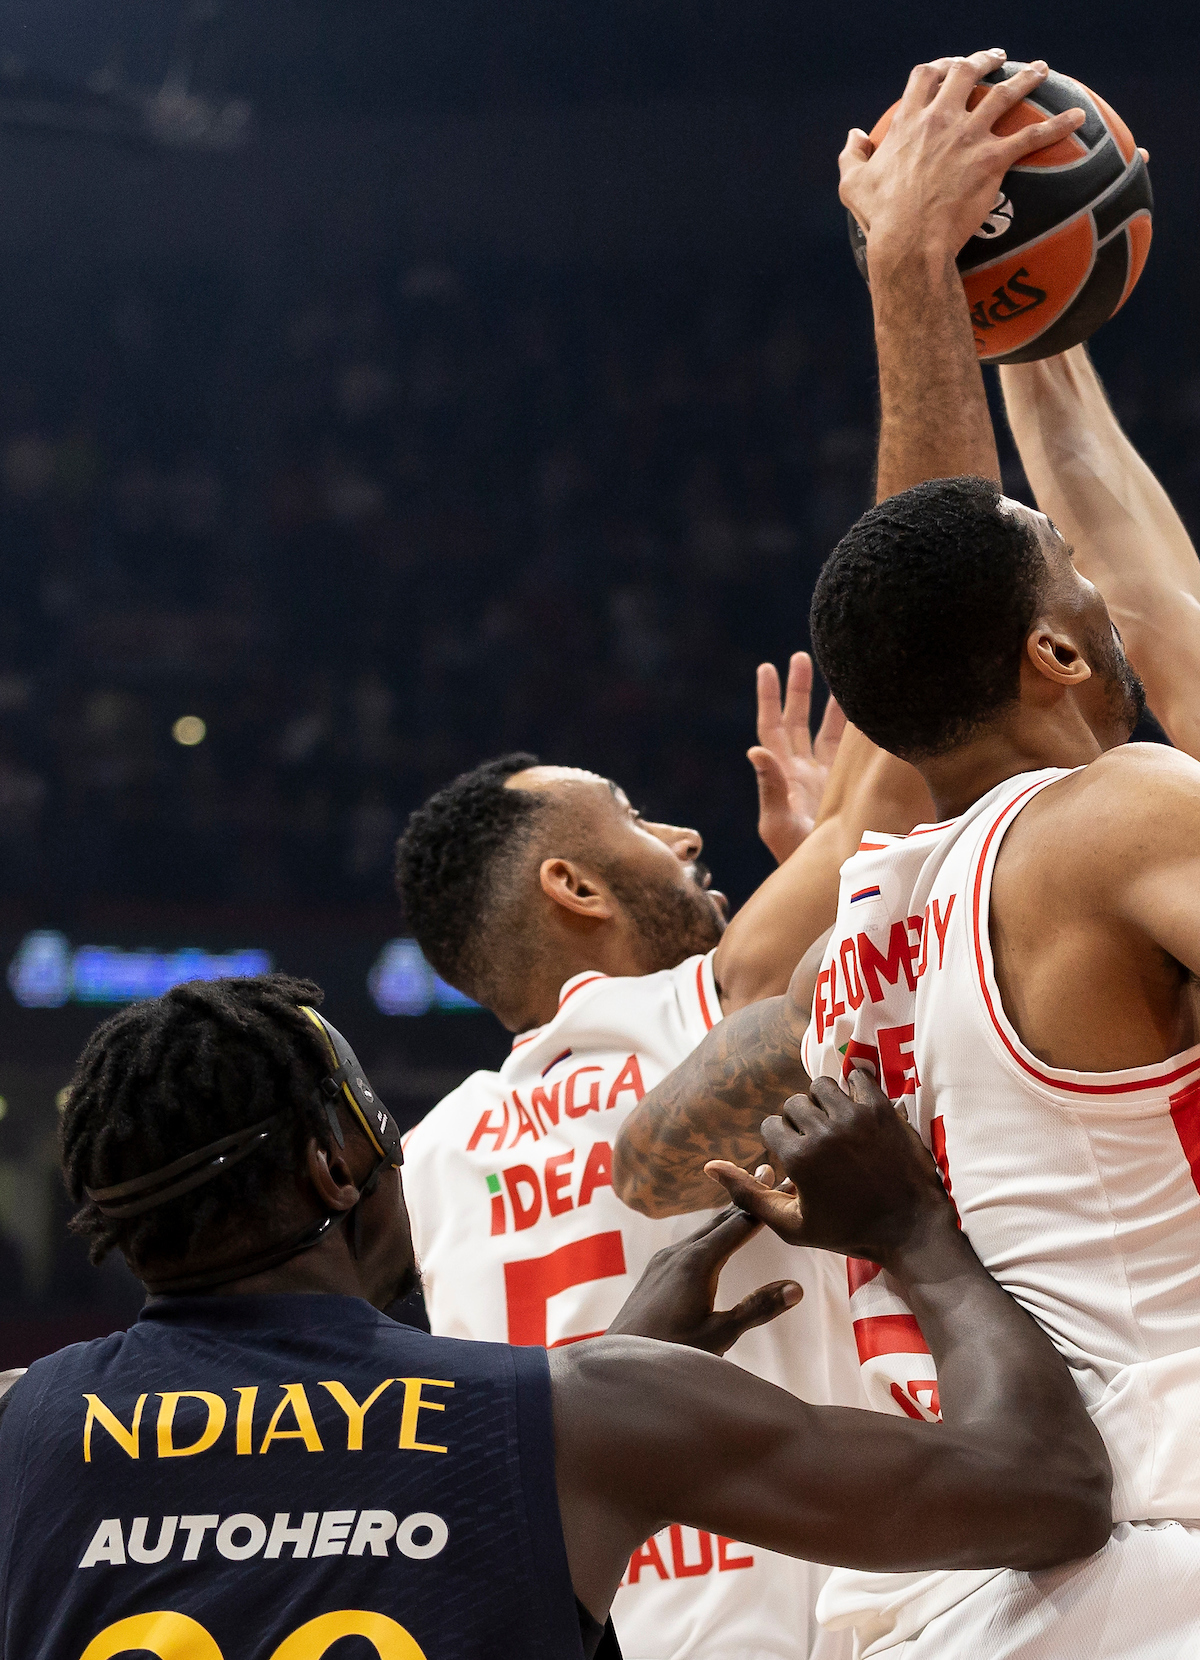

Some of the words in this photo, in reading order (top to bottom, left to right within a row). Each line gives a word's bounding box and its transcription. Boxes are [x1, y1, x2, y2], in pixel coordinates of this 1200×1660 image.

[466, 1053, 647, 1152] HANGA
[82, 1377, 455, 1463] NDIAYE
[78, 1509, 449, 1569] AUTOHERO
